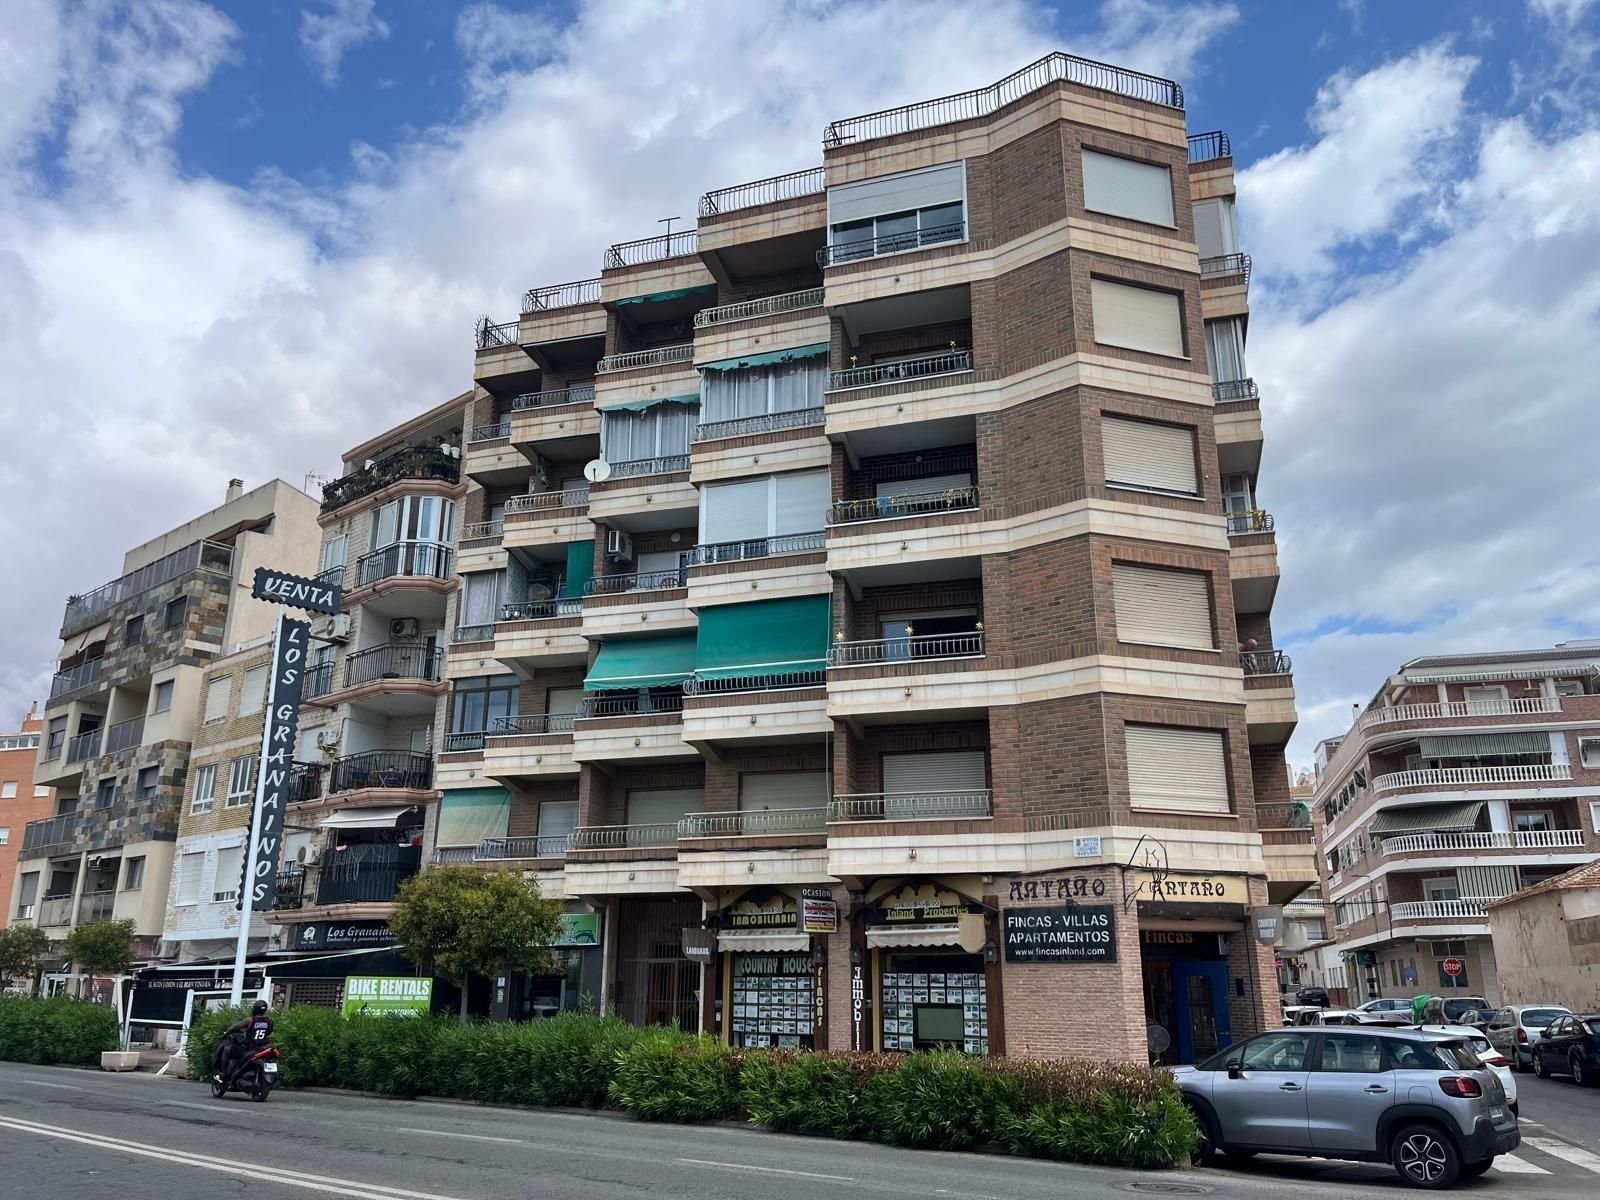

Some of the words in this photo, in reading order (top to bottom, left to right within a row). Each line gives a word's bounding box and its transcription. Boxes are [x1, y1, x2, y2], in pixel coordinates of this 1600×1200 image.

[264, 577, 333, 606] VENTA
[281, 627, 301, 685] LOS
[252, 703, 293, 902] GRANAINOS
[802, 888, 831, 898] OCASION
[1009, 876, 1105, 900] ANTAÑO
[887, 908, 914, 918] Inland
[923, 905, 969, 917] Properties
[732, 913, 797, 926] INMOBILIARIA
[1008, 916, 1052, 928] FINCAS
[1062, 914, 1108, 927] VILLAS
[327, 927, 345, 937] Los
[1008, 931, 1110, 944] APARTAMENTOS
[1145, 930, 1193, 944] fincas
[1015, 947, 1105, 956] www.fincasinland.com
[741, 957, 778, 974] COUNTRY
[1445, 963, 1461, 971] STOP
[348, 979, 379, 995] BIKE
[380, 980, 431, 996] RENTALS
[254, 1030, 266, 1040] 15
